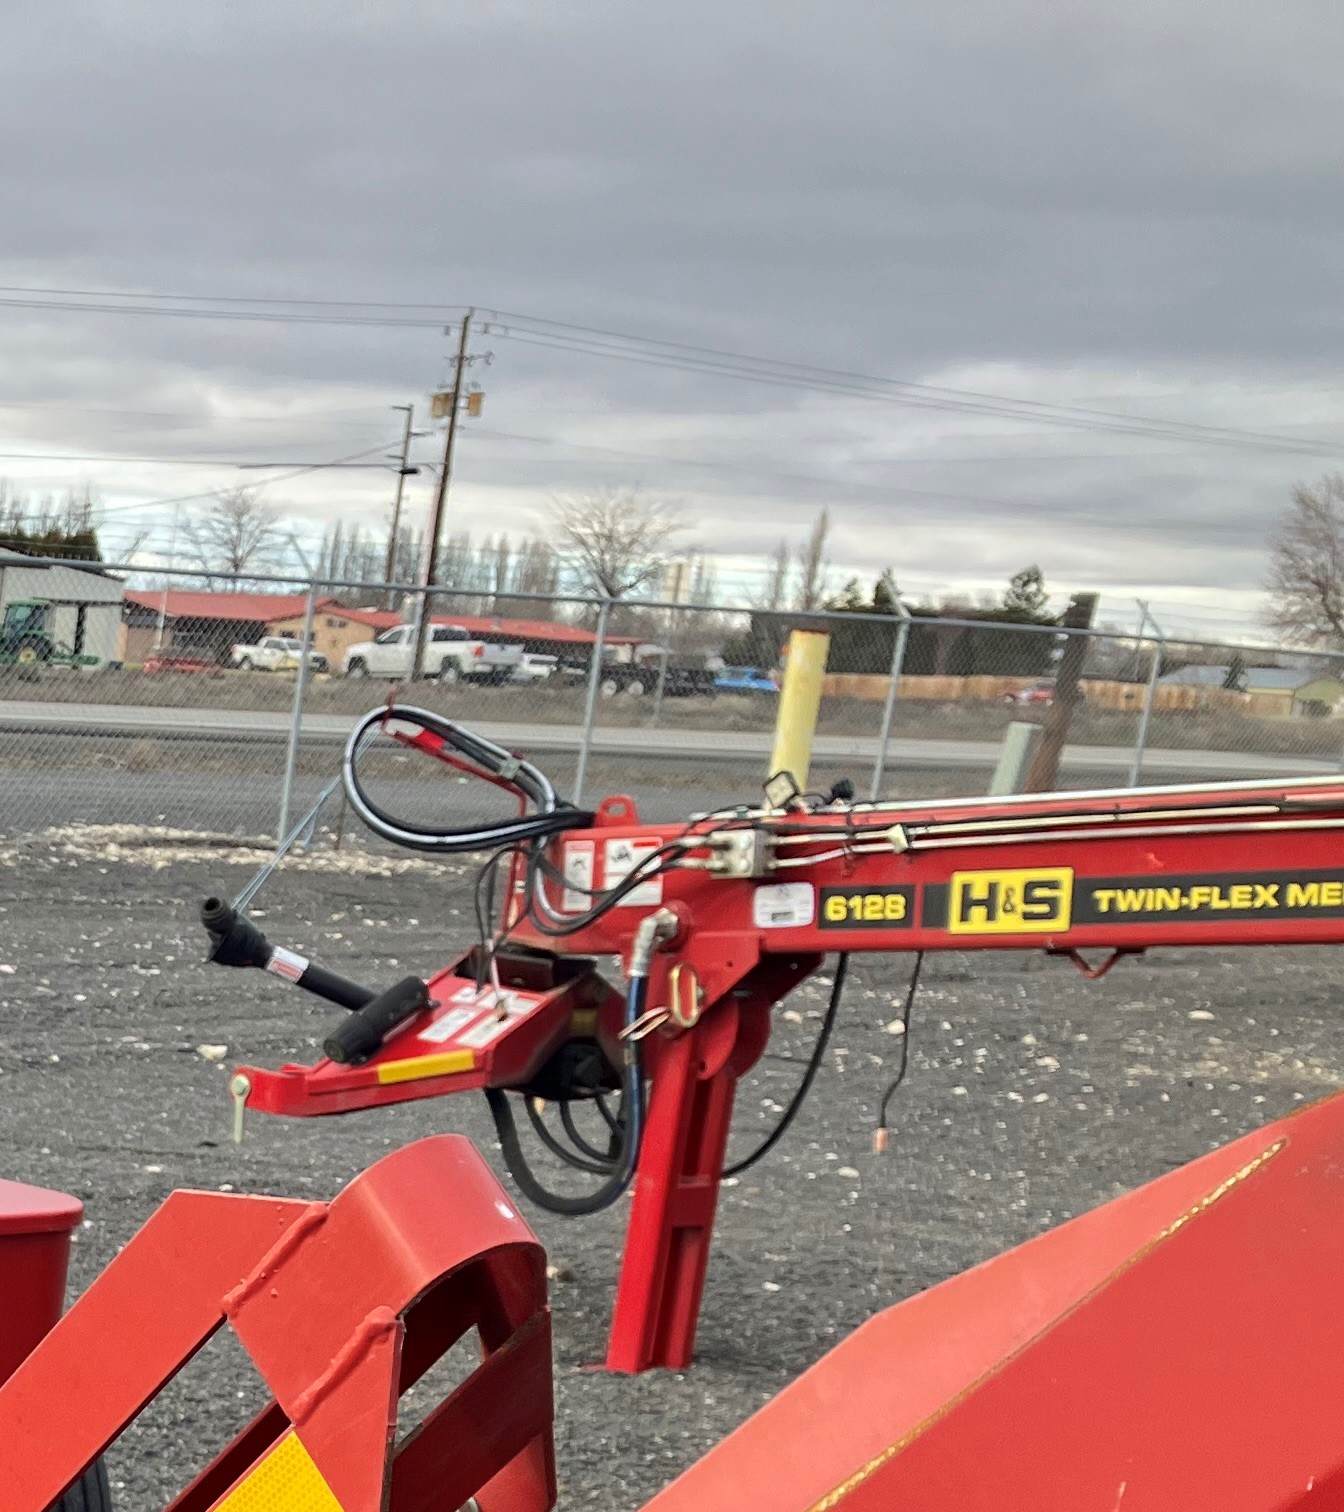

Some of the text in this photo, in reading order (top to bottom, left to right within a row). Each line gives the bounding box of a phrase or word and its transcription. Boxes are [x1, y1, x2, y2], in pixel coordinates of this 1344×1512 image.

[825, 893, 907, 922] 6128
[960, 880, 1062, 923] H&S
[1092, 881, 1344, 913] TWIN-FLEX ME
